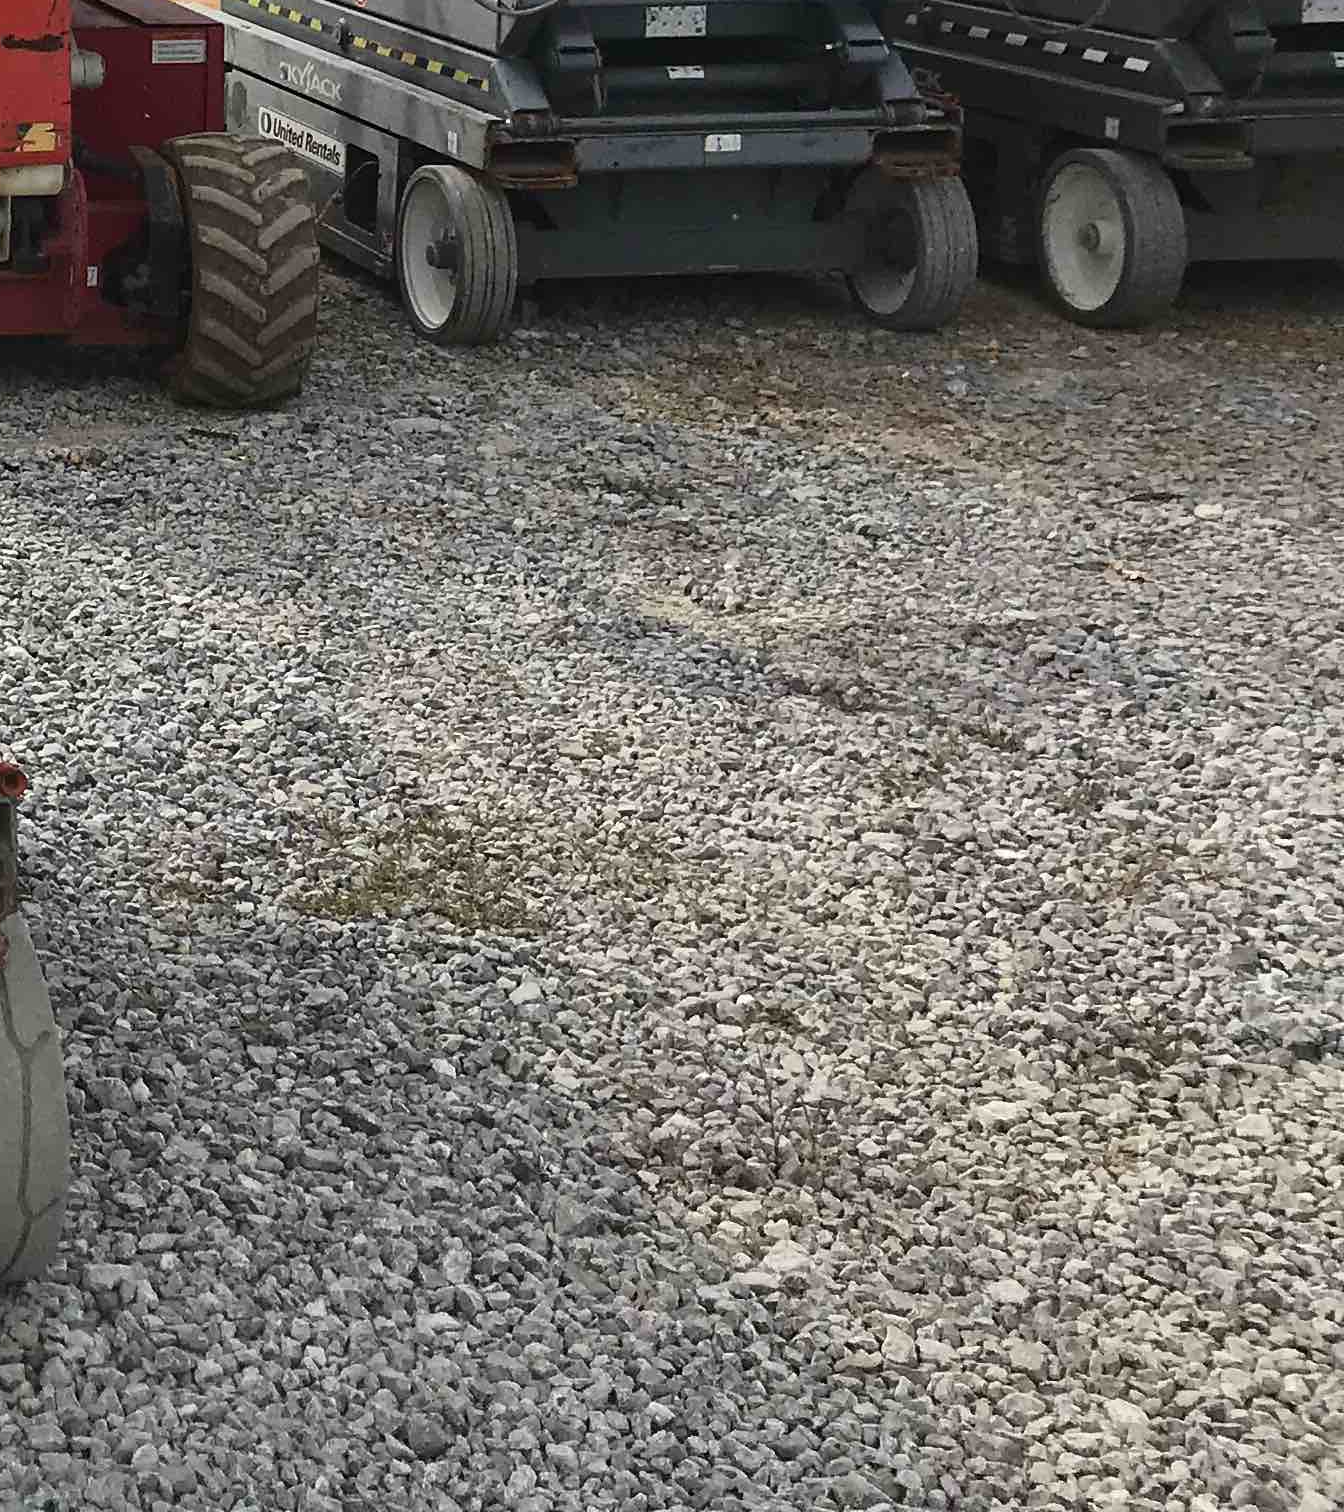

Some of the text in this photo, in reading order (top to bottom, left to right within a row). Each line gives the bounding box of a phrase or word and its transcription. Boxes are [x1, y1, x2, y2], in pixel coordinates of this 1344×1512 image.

[279, 61, 343, 102] SKYJACK
[273, 120, 341, 167] United Rentals
